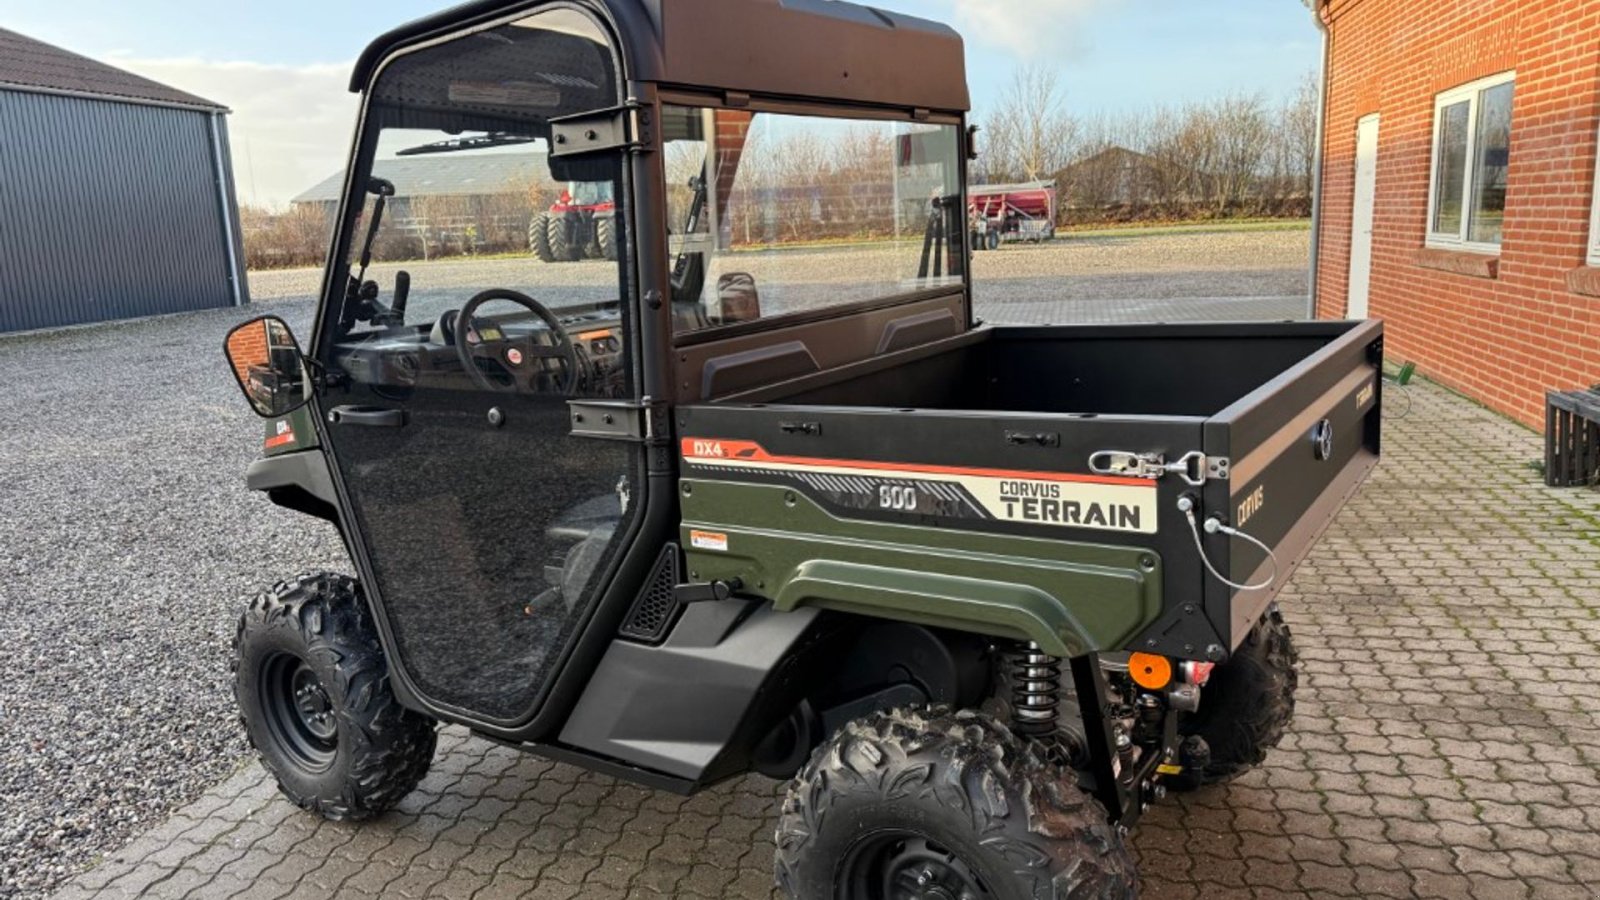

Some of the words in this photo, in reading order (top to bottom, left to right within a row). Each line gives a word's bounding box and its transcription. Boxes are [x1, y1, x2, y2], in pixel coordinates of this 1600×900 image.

[879, 485, 916, 510] 800
[1000, 481, 1060, 498] CORVUS
[999, 496, 1140, 529] TERRAIN
